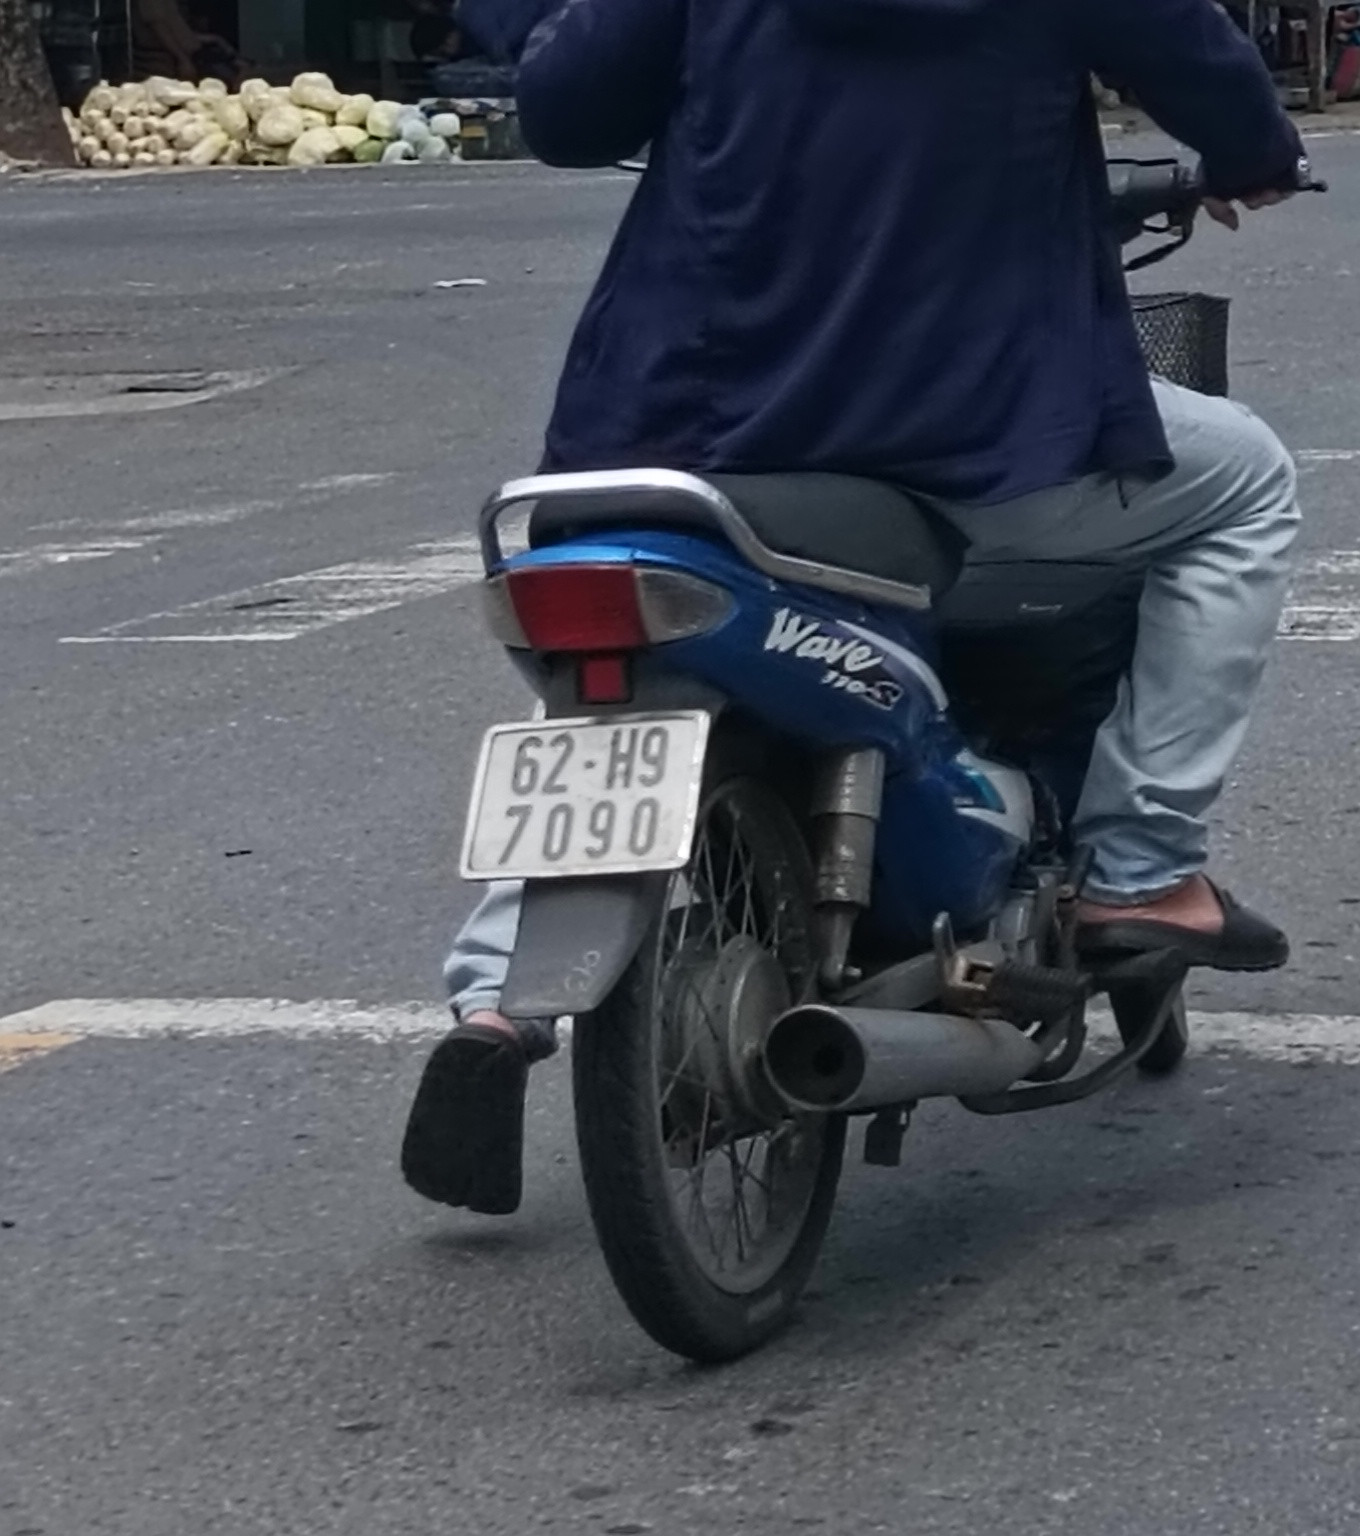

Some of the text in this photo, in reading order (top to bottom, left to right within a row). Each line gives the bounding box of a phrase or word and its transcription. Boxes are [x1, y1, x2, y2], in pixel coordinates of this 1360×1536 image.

[764, 607, 884, 672] Wave
[511, 726, 670, 796] 62-H9
[499, 797, 661, 862] 7090
